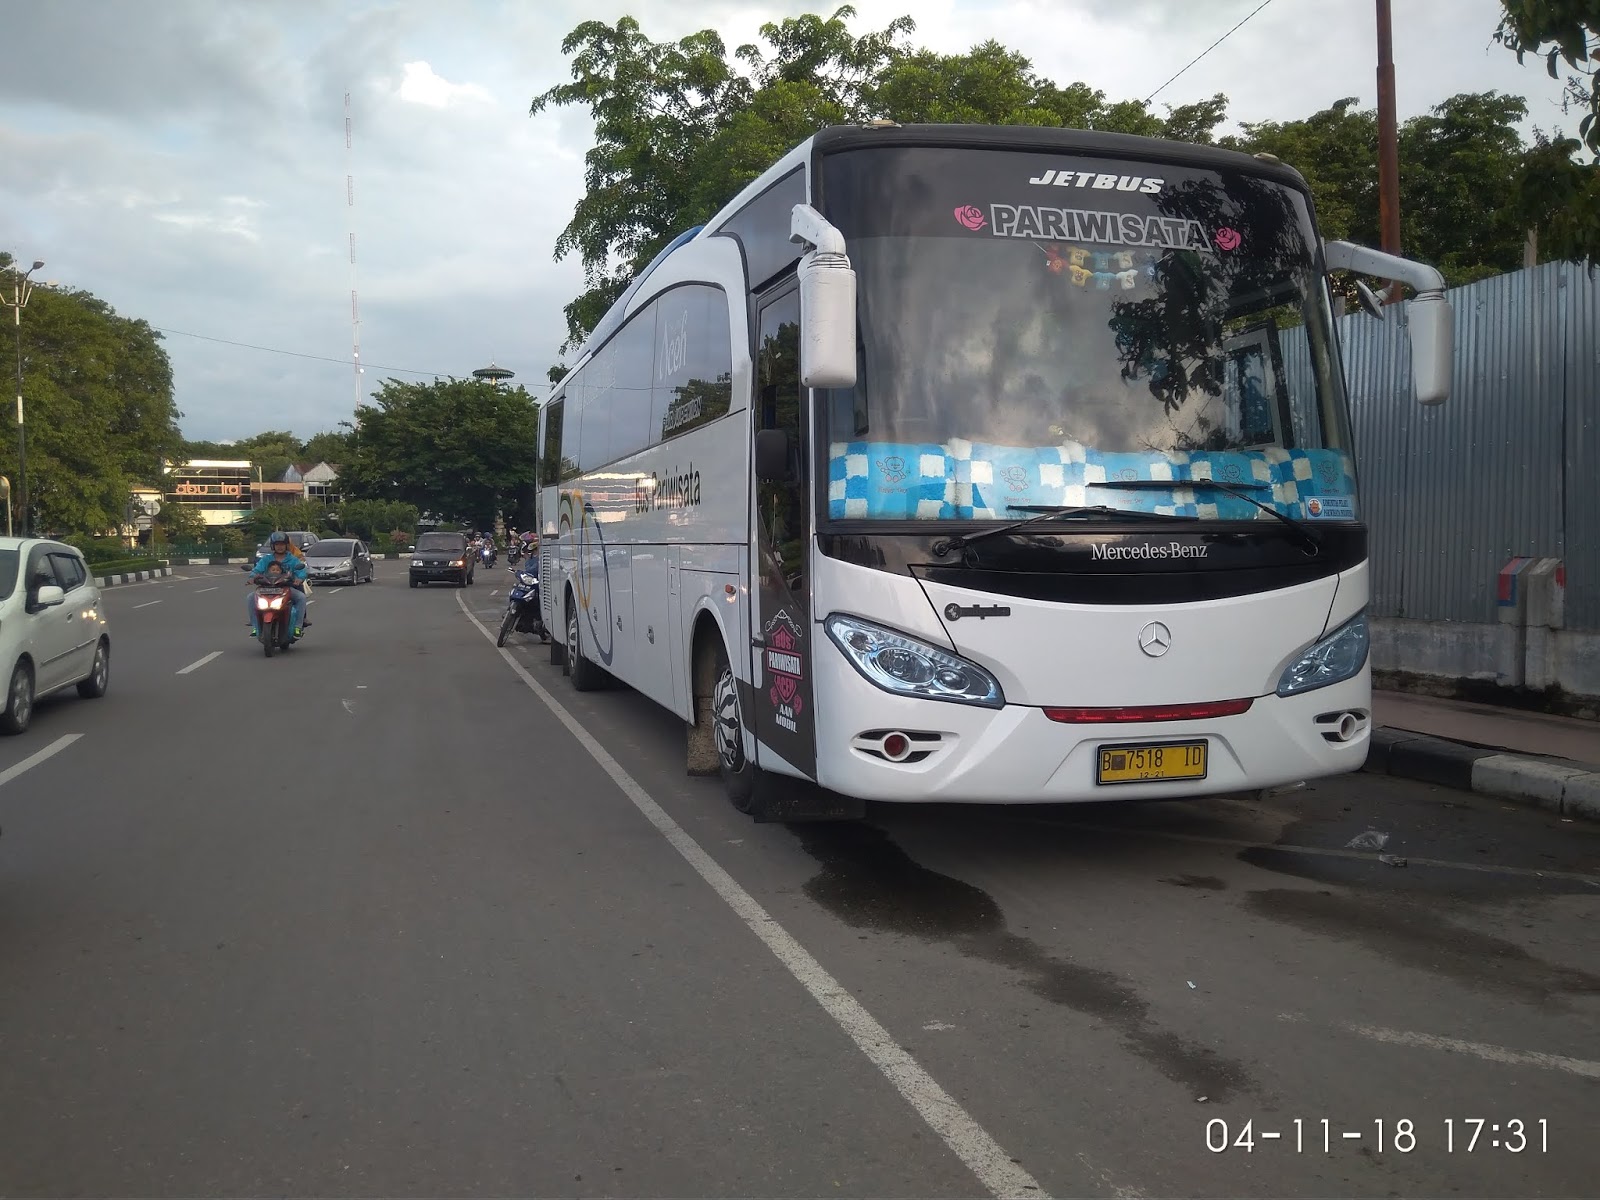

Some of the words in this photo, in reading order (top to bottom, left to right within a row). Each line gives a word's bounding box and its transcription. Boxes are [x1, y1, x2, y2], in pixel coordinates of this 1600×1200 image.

[1029, 170, 1165, 194] JETBUS
[990, 203, 1213, 251] PARIWISATA
[651, 461, 701, 512] Pariwisata
[1091, 542, 1208, 560] Mercedes-Benz
[775, 631, 792, 650] BUS
[768, 651, 801, 675] PARIWISATA
[775, 713, 798, 733] MOBIL
[780, 704, 793, 719] AAN
[1103, 752, 1112, 771] B
[1126, 749, 1163, 769] 7518
[1185, 746, 1202, 766] ID
